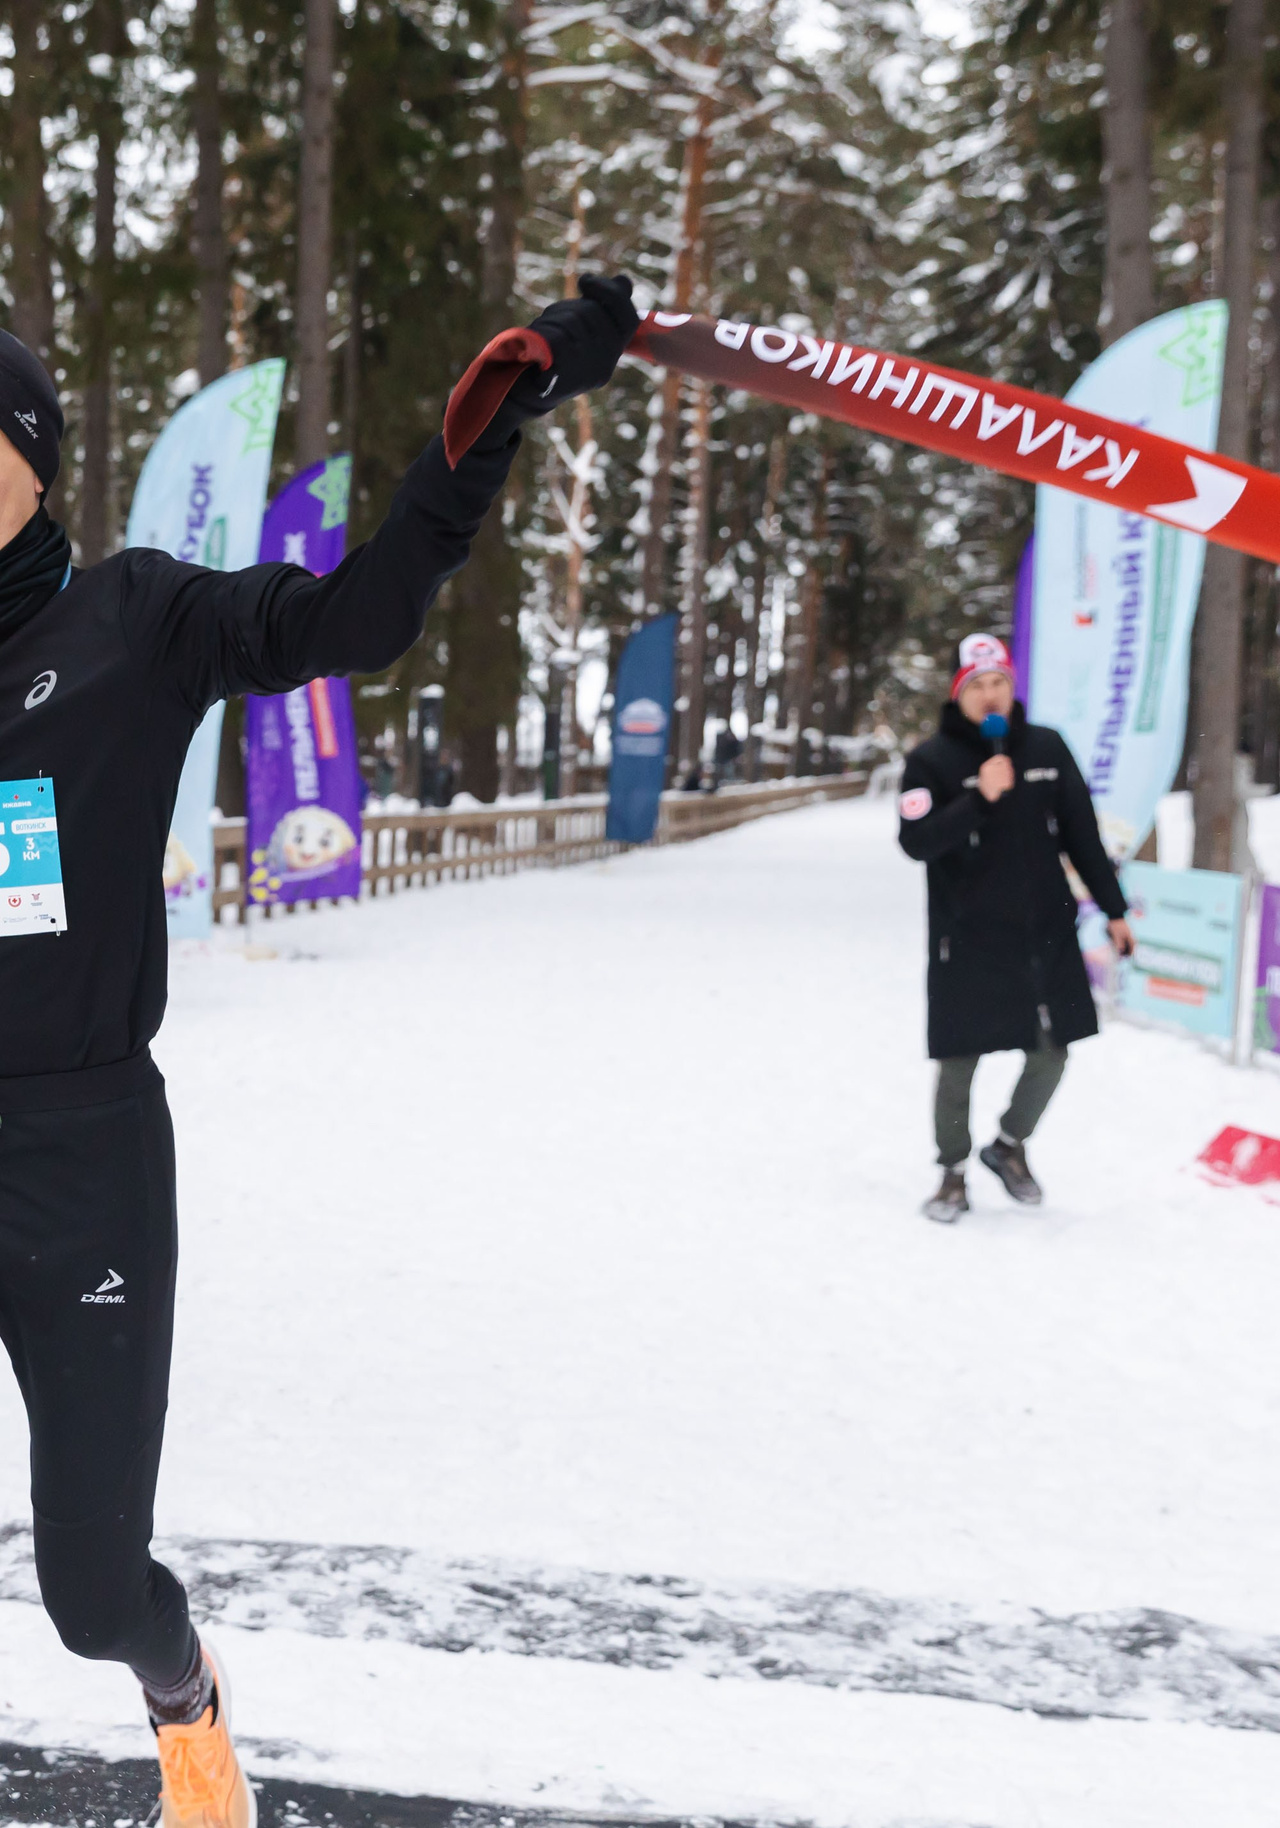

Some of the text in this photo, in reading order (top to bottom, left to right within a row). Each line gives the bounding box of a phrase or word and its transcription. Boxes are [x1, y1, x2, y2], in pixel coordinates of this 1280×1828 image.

[714, 318, 1140, 488] КАЛАШНИКОВ
[14, 411, 39, 439] DEMIX
[16, 821, 47, 831] ВОТКИНСК
[25, 837, 35, 850] 3
[23, 850, 40, 861] КМ
